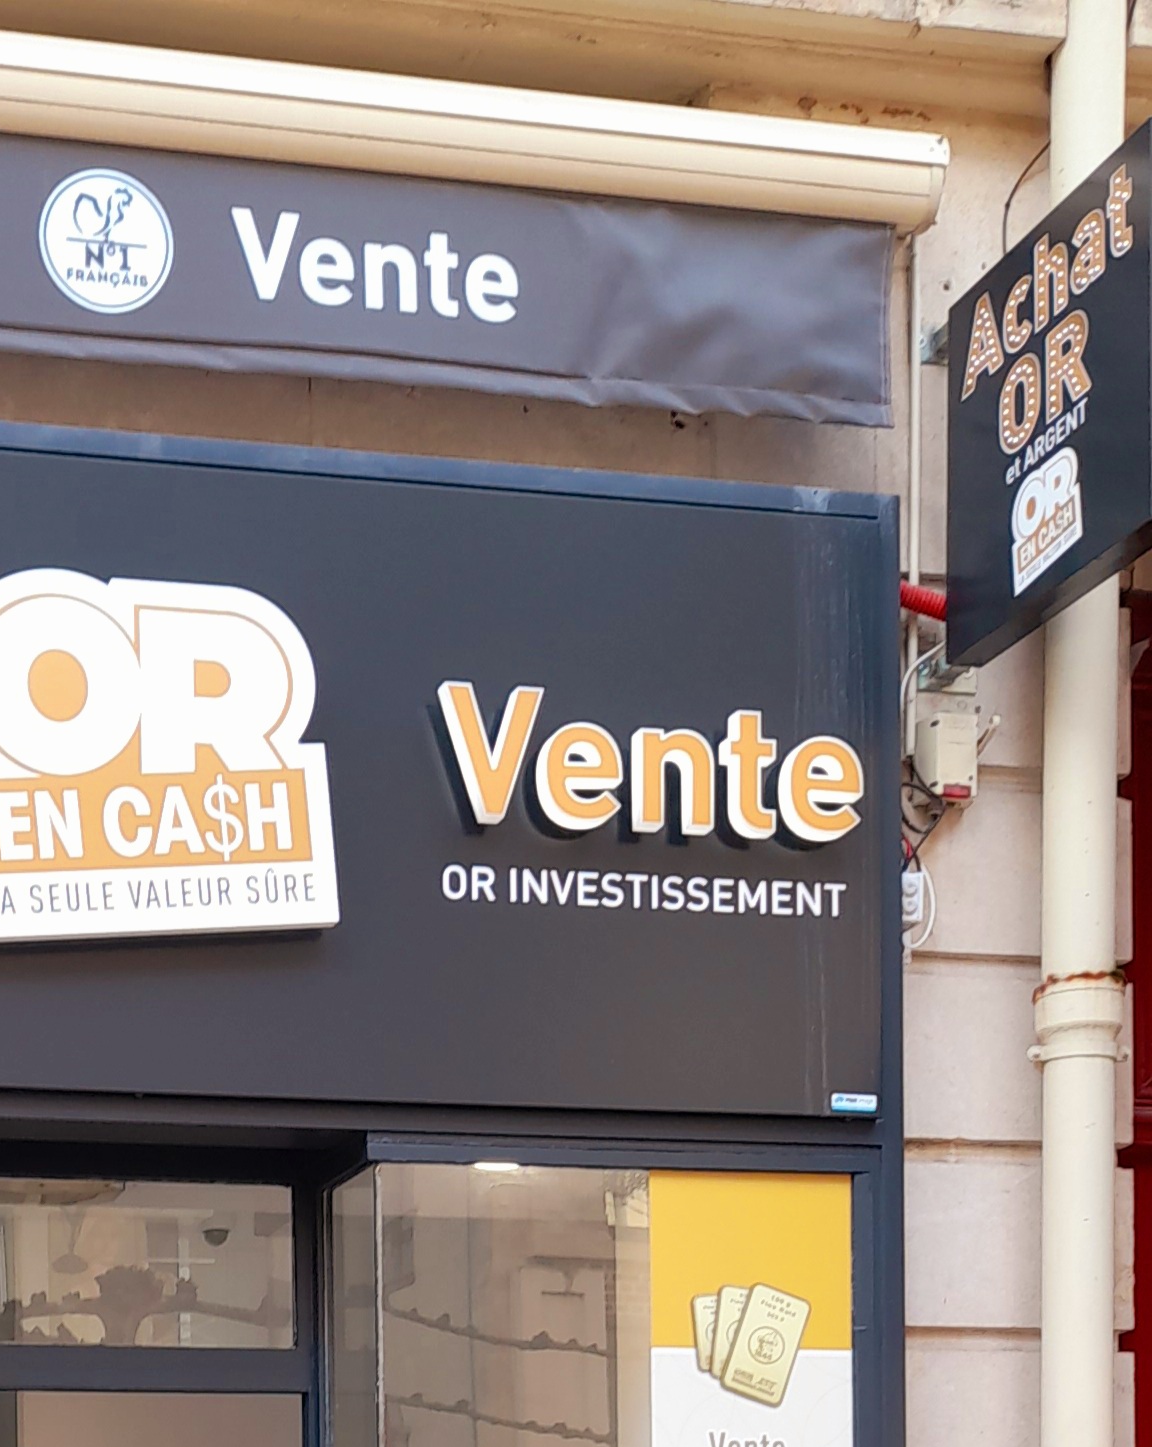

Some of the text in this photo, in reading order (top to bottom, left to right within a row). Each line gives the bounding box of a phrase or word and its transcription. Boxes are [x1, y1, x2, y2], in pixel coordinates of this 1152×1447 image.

[66, 267, 149, 288] FRANÇAIS
[230, 206, 520, 324] Vente
[961, 163, 1135, 402] Achat
[998, 309, 1093, 456] OR
[1005, 396, 1088, 485] et ARGENT
[1016, 455, 1074, 539] OR
[438, 679, 865, 843] Vente
[29, 880, 115, 914] SEULE
[126, 876, 233, 910] VALEUR
[246, 867, 317, 905] SÛRE
[441, 864, 847, 919] OR INVESTISSEMENT
